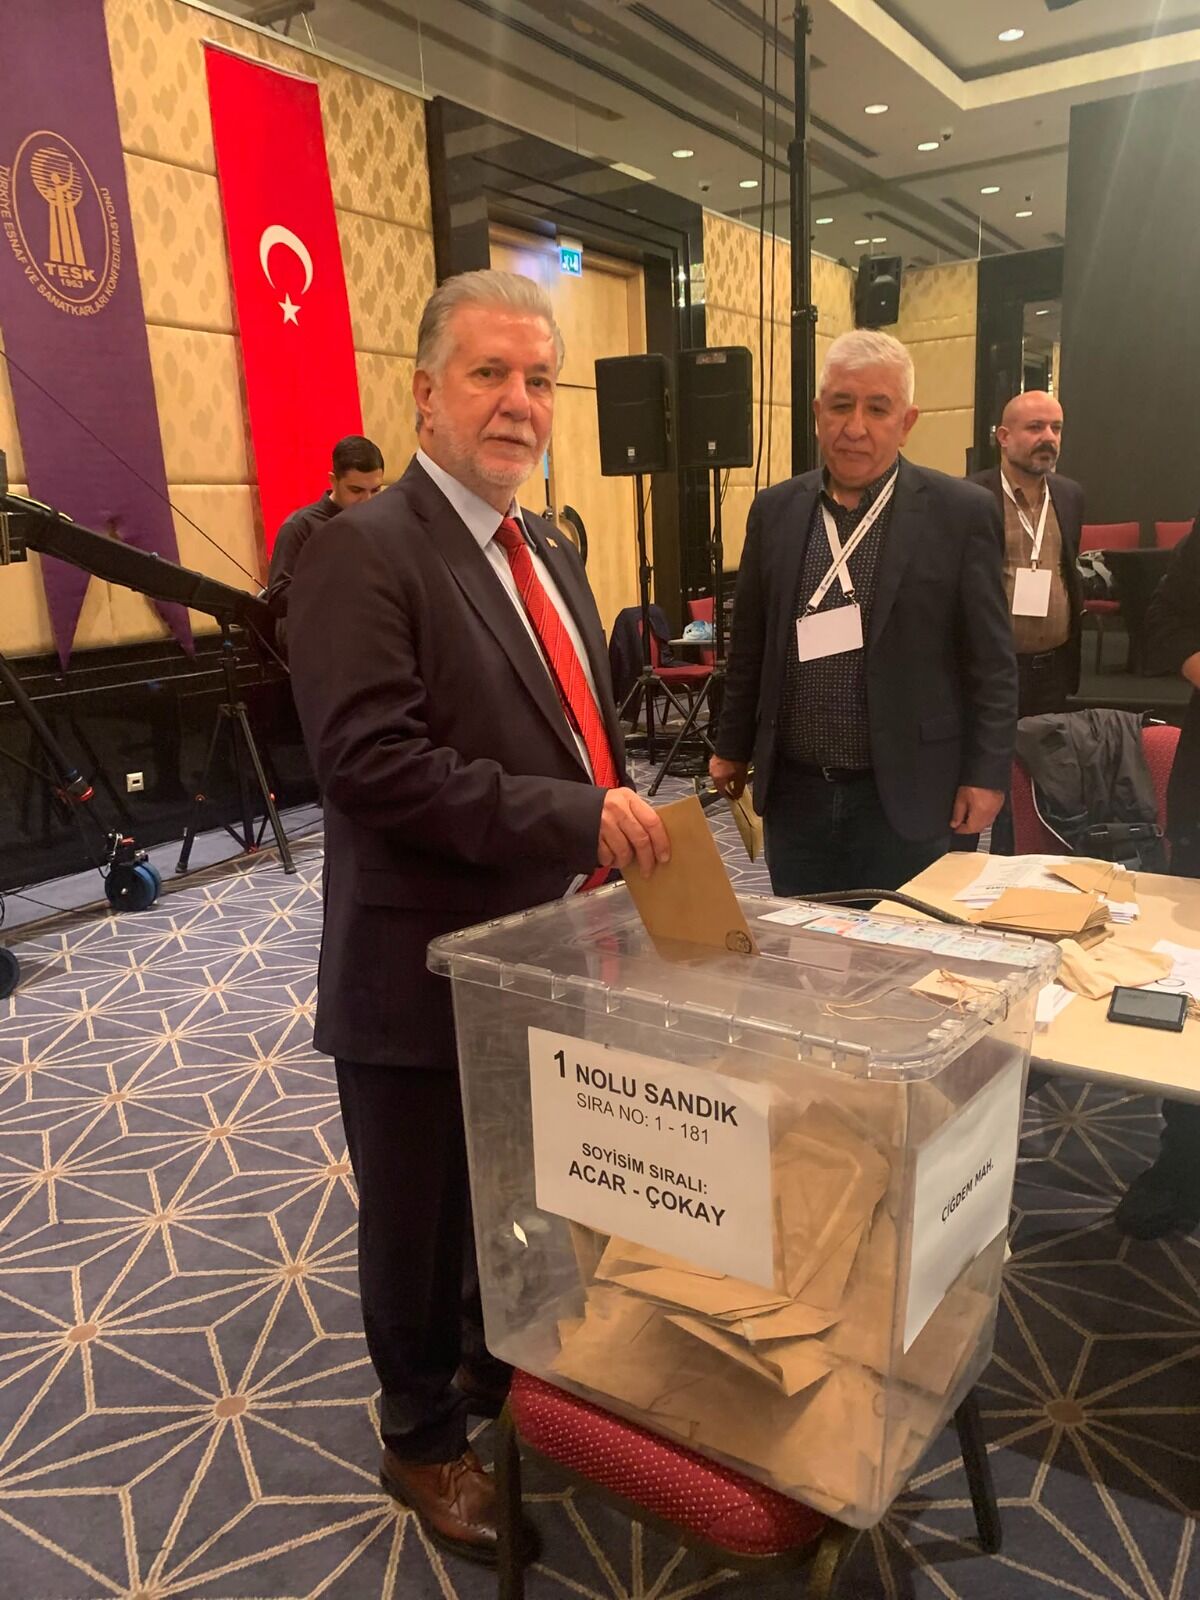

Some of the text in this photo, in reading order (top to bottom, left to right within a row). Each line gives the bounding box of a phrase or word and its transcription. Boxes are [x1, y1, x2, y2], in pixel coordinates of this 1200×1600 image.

[3, 222, 29, 264] ESNAF
[24, 265, 40, 285] VE
[101, 187, 121, 297] KONFEDERASYONU
[43, 262, 97, 282] TESK
[553, 1050, 738, 1127] 1 NOLU SANDIK
[576, 1092, 614, 1117] SIRA
[619, 1105, 649, 1127] NO:
[655, 1116, 662, 1131] 1
[680, 1123, 709, 1145] 181
[568, 1160, 627, 1195] ACAR
[645, 1186, 726, 1227] ÇOKAY
[582, 1142, 708, 1195] SOYİSİM SIRALI:
[974, 1157, 994, 1187] MAH.
